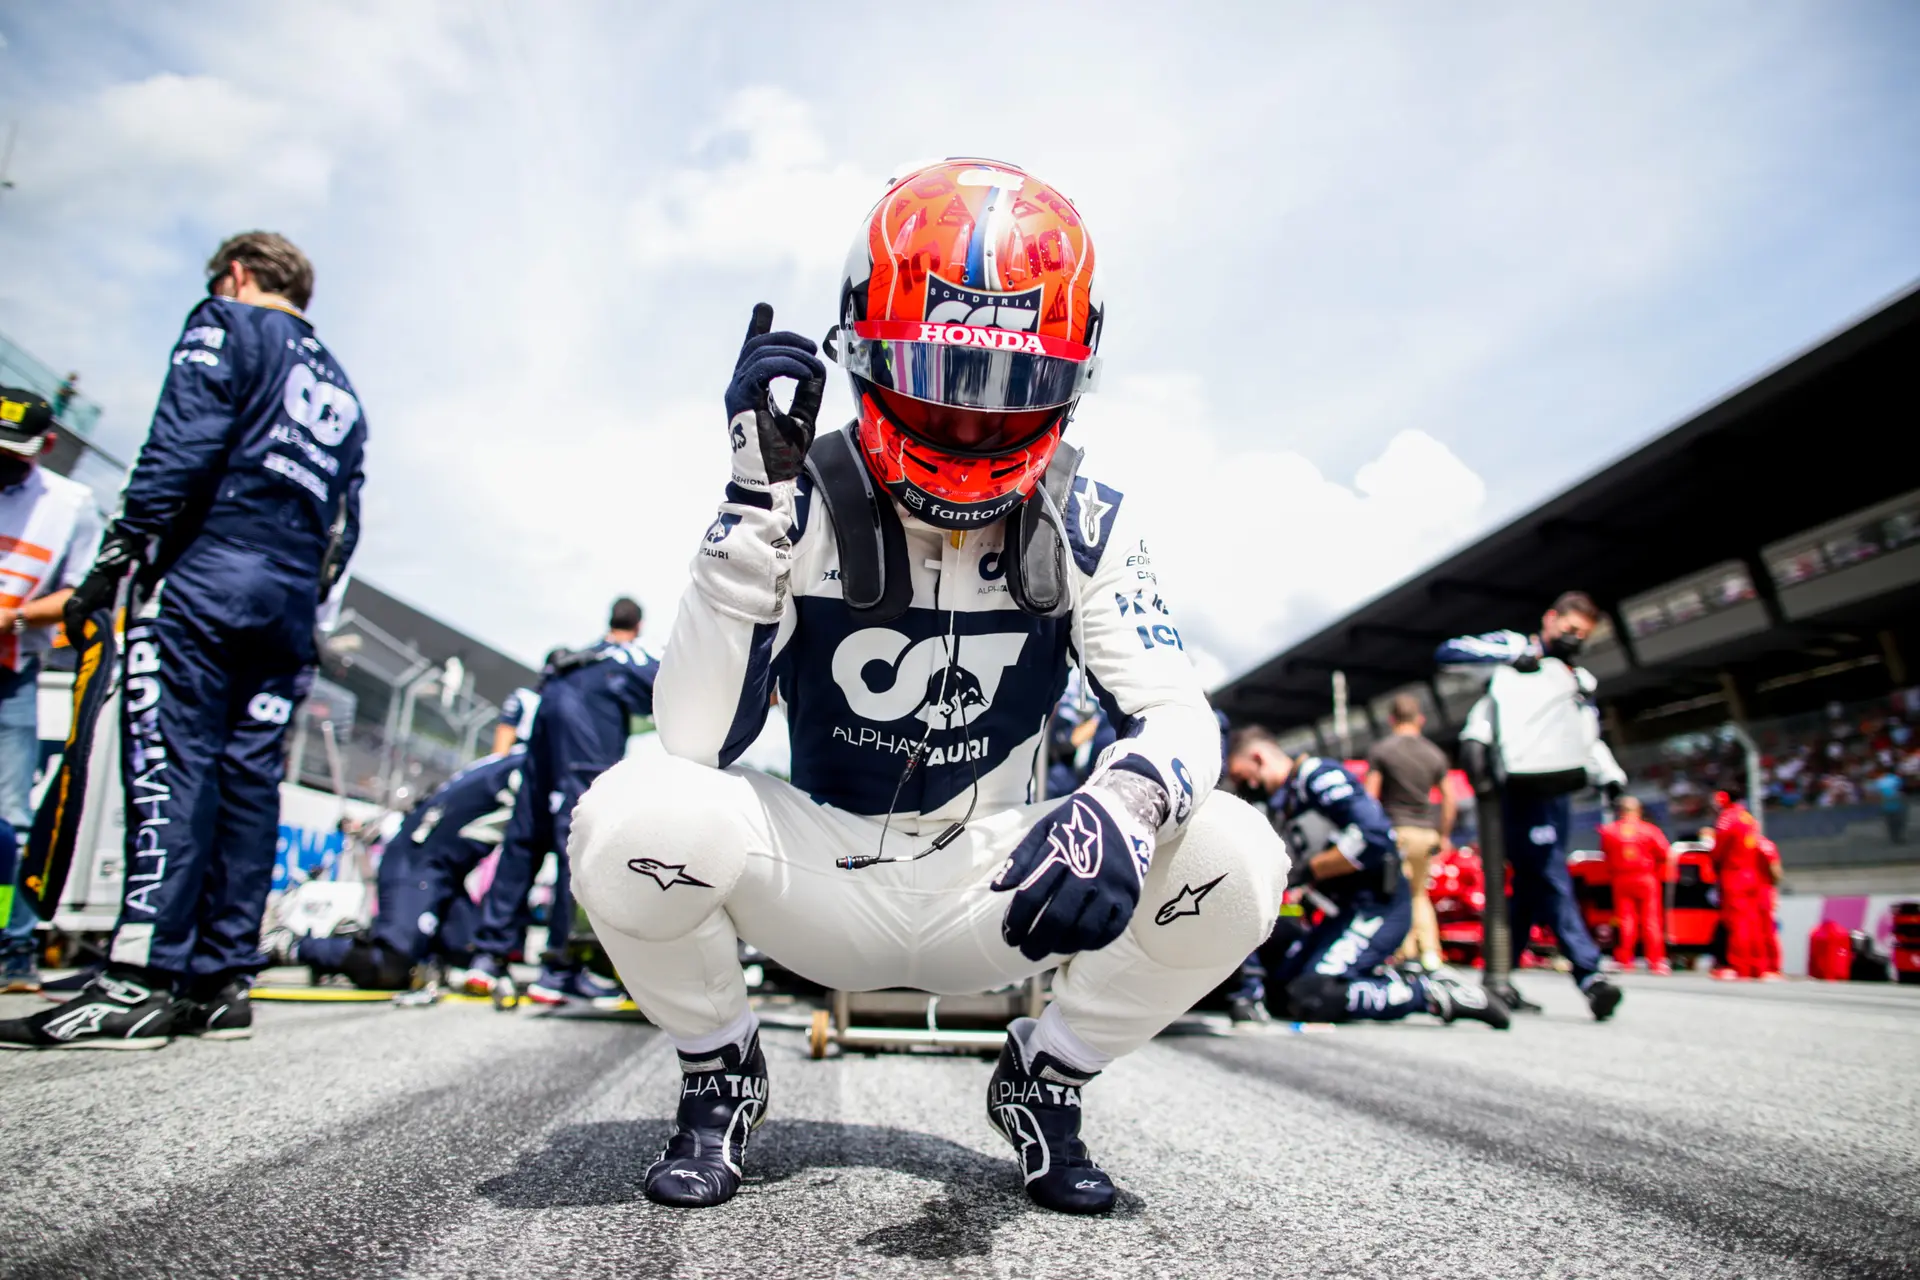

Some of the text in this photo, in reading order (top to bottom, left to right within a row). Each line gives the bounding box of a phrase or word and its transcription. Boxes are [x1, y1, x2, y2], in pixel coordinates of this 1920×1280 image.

[930, 287, 1032, 307] SCUDERIA
[918, 324, 1047, 354] HONDA
[930, 499, 1014, 521] fantom
[699, 547, 729, 560] TAURI
[1136, 624, 1184, 650] IC
[125, 624, 171, 914] ALPHATAURI
[724, 1074, 768, 1101] TAU
[1045, 1083, 1082, 1108] TA
